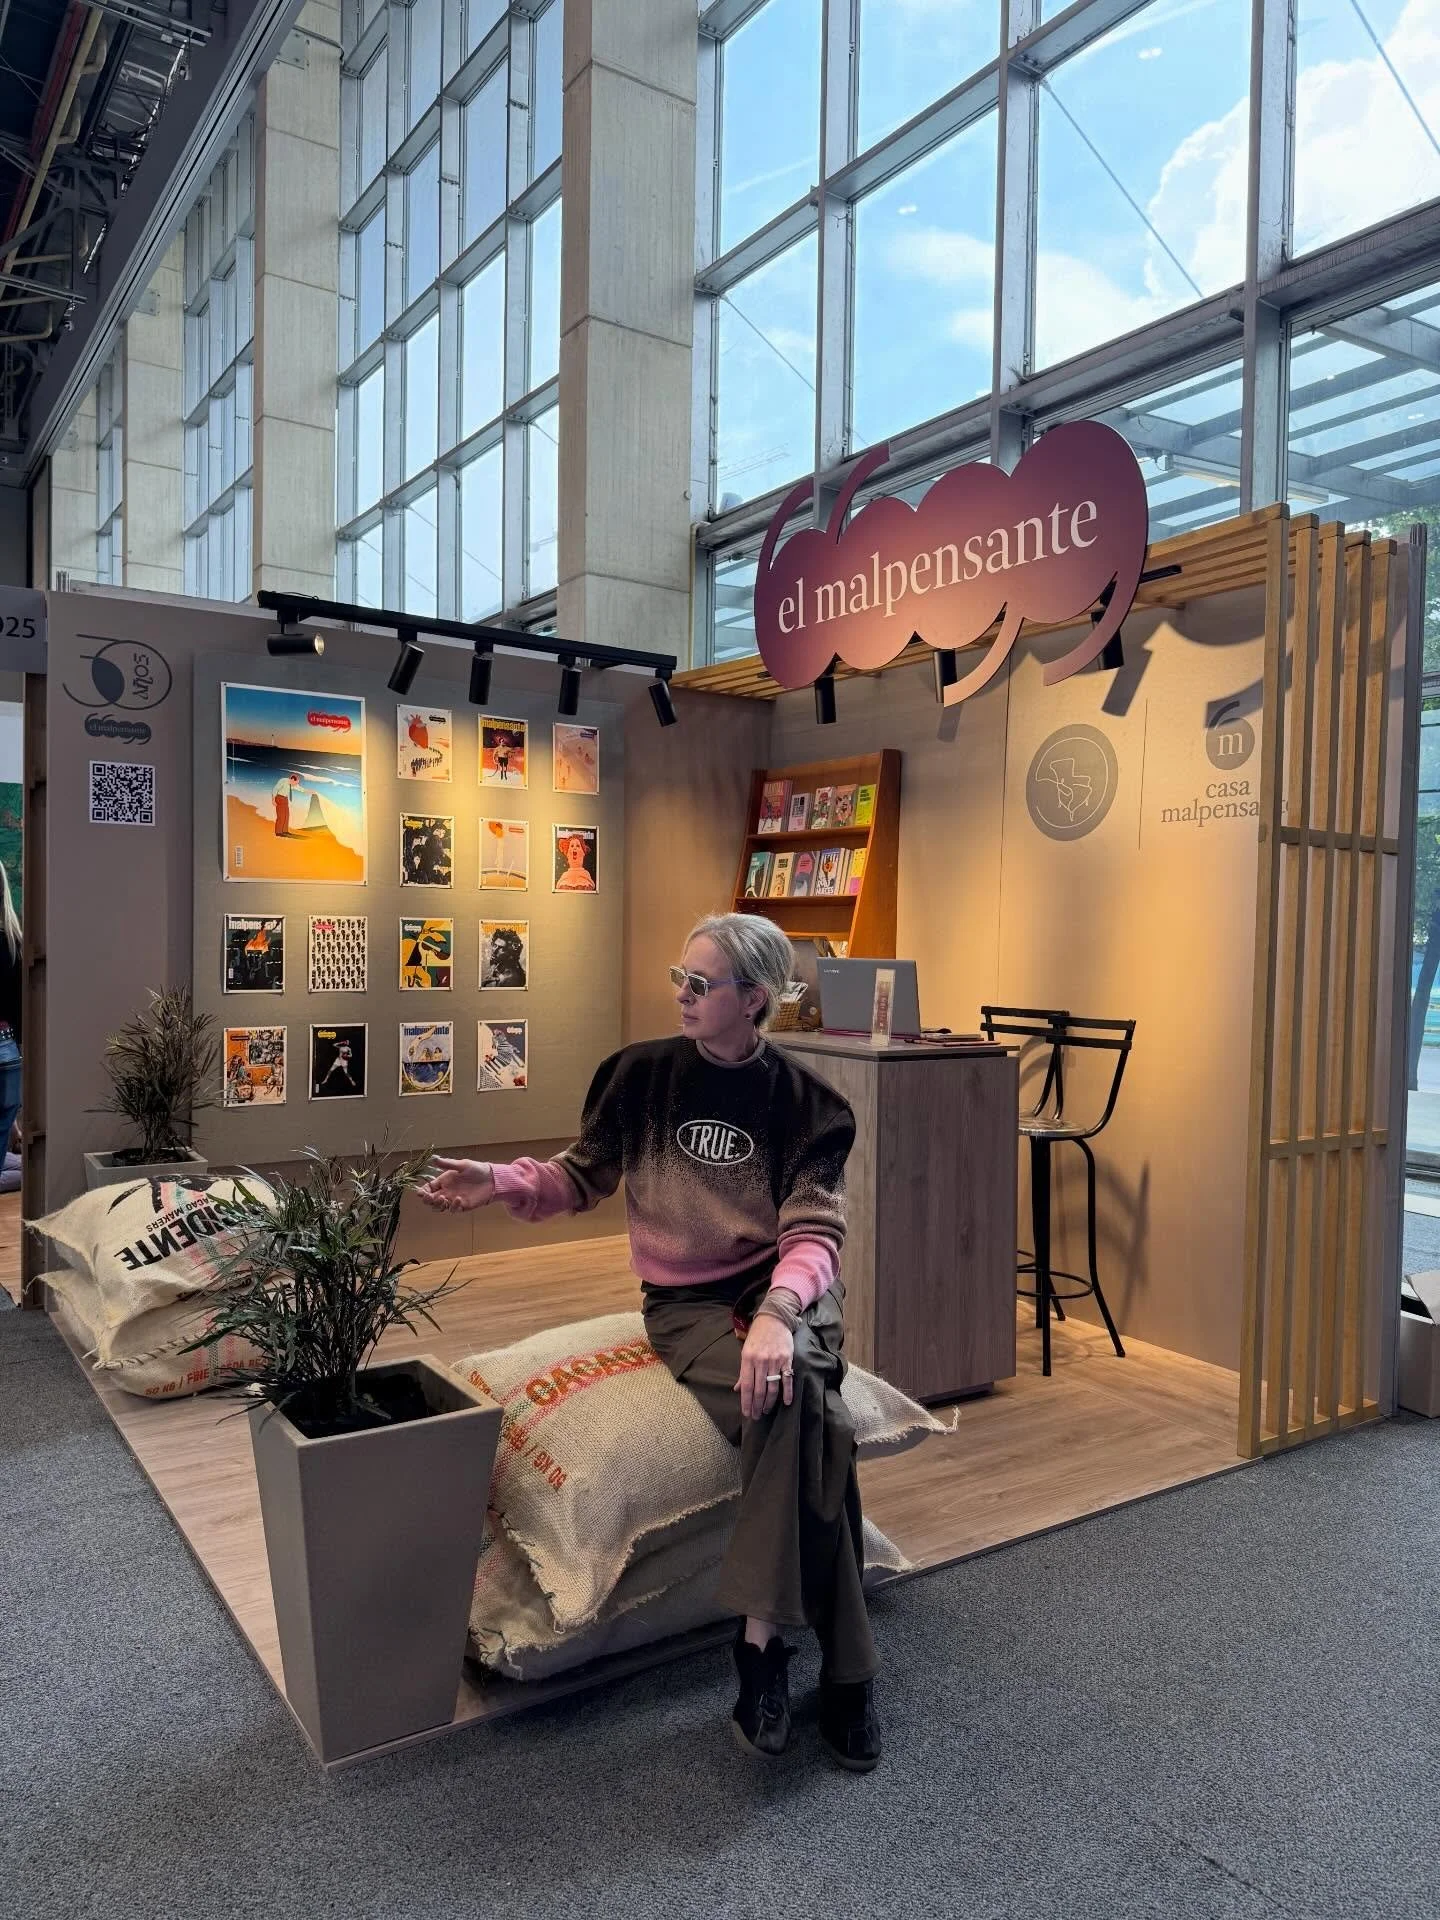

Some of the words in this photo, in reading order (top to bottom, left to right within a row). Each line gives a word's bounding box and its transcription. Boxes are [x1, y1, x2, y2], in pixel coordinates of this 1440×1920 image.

[778, 577, 805, 634] el
[814, 500, 1098, 618] malpensante
[0, 616, 36, 639] 25
[1216, 732, 1245, 756] m
[1205, 780, 1251, 799] casa
[1160, 797, 1289, 828] malpensa
[184, 1194, 215, 1212] ACAO
[145, 1205, 184, 1233] MAKERS
